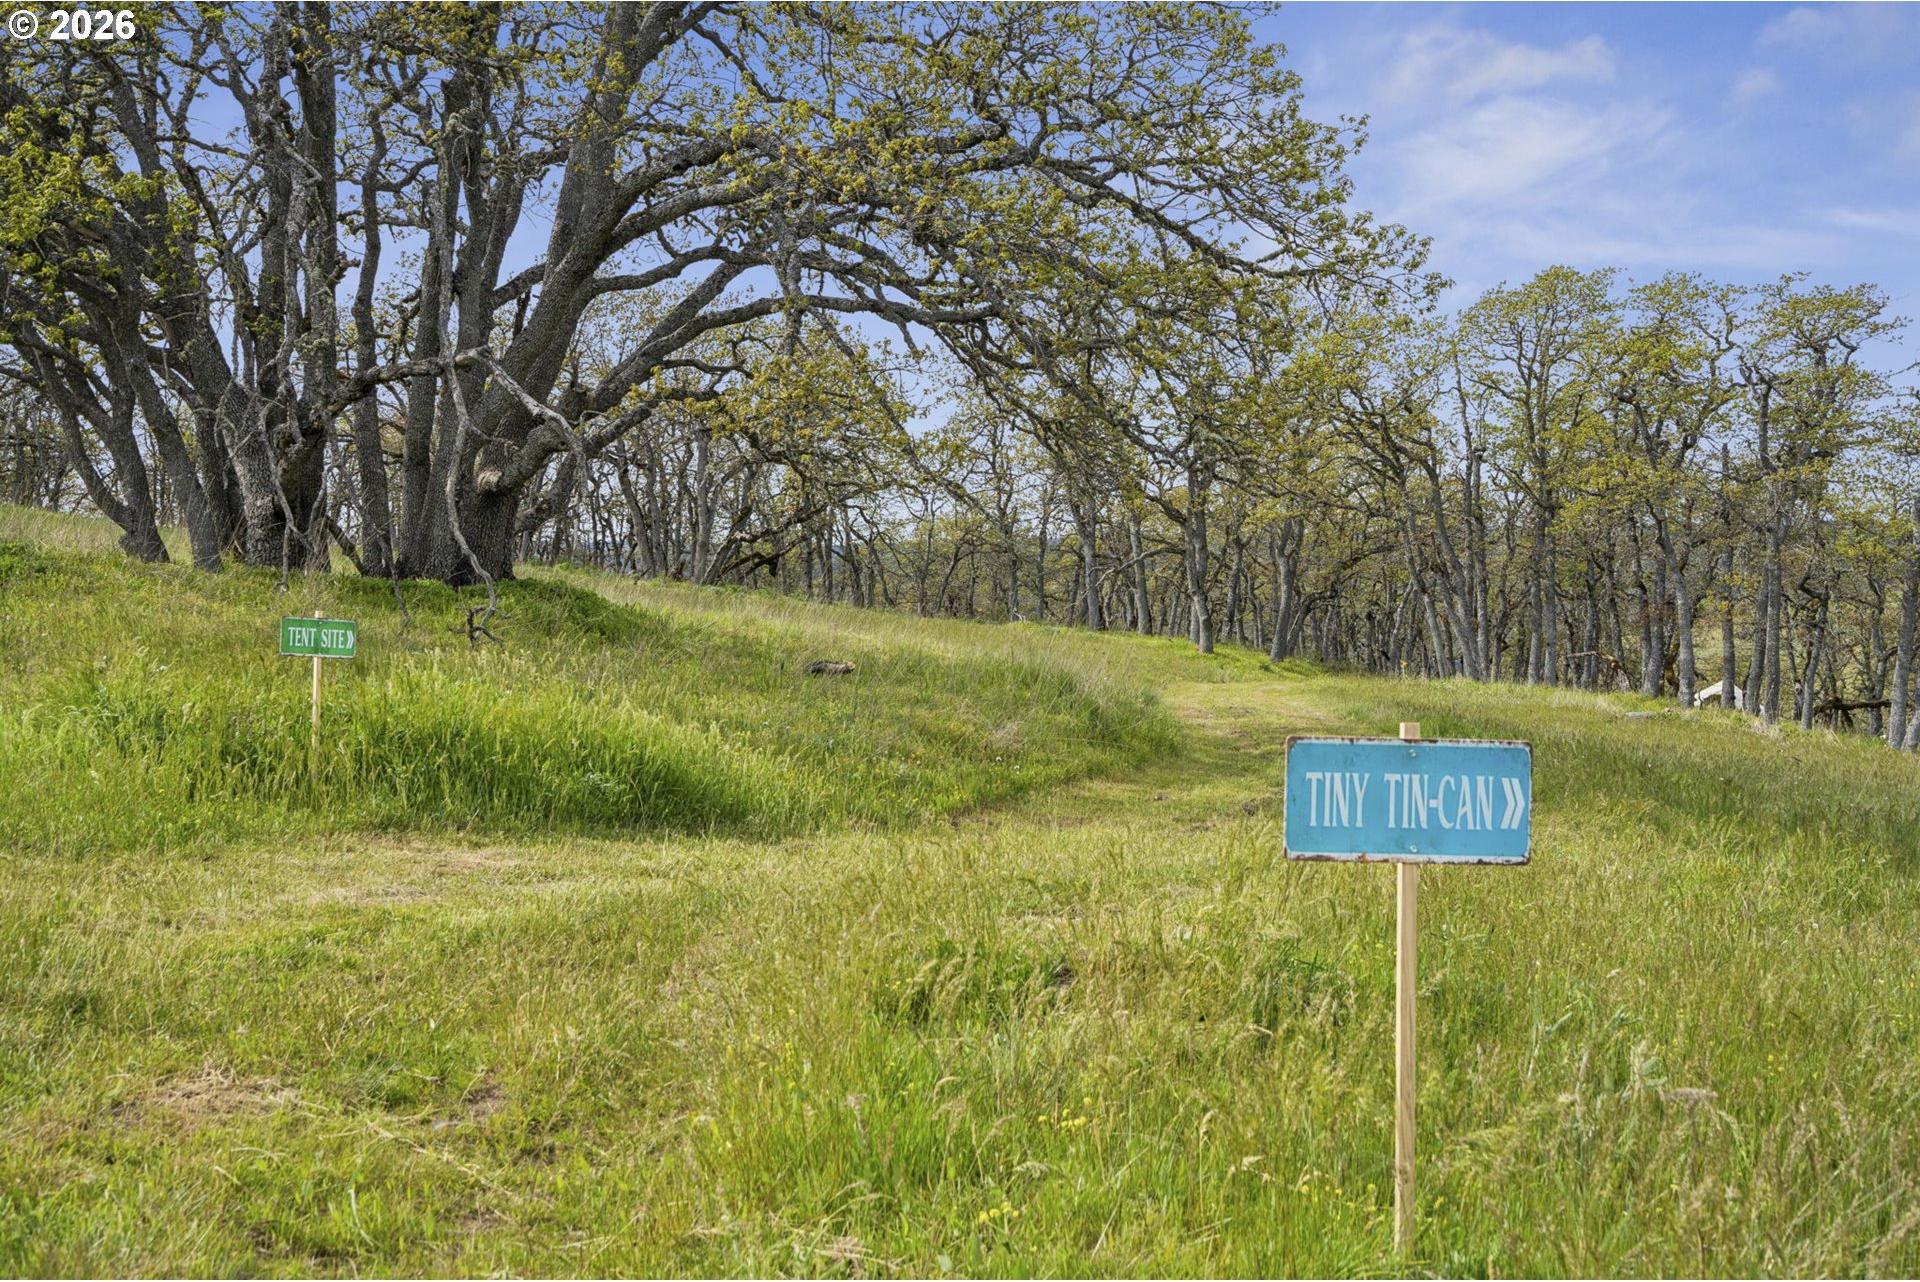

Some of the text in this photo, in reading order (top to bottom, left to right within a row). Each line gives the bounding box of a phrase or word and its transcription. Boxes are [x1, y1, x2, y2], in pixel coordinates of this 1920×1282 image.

[288, 627, 345, 649] TENT SITE
[1305, 771, 1494, 831] TINY TIN-CAN
